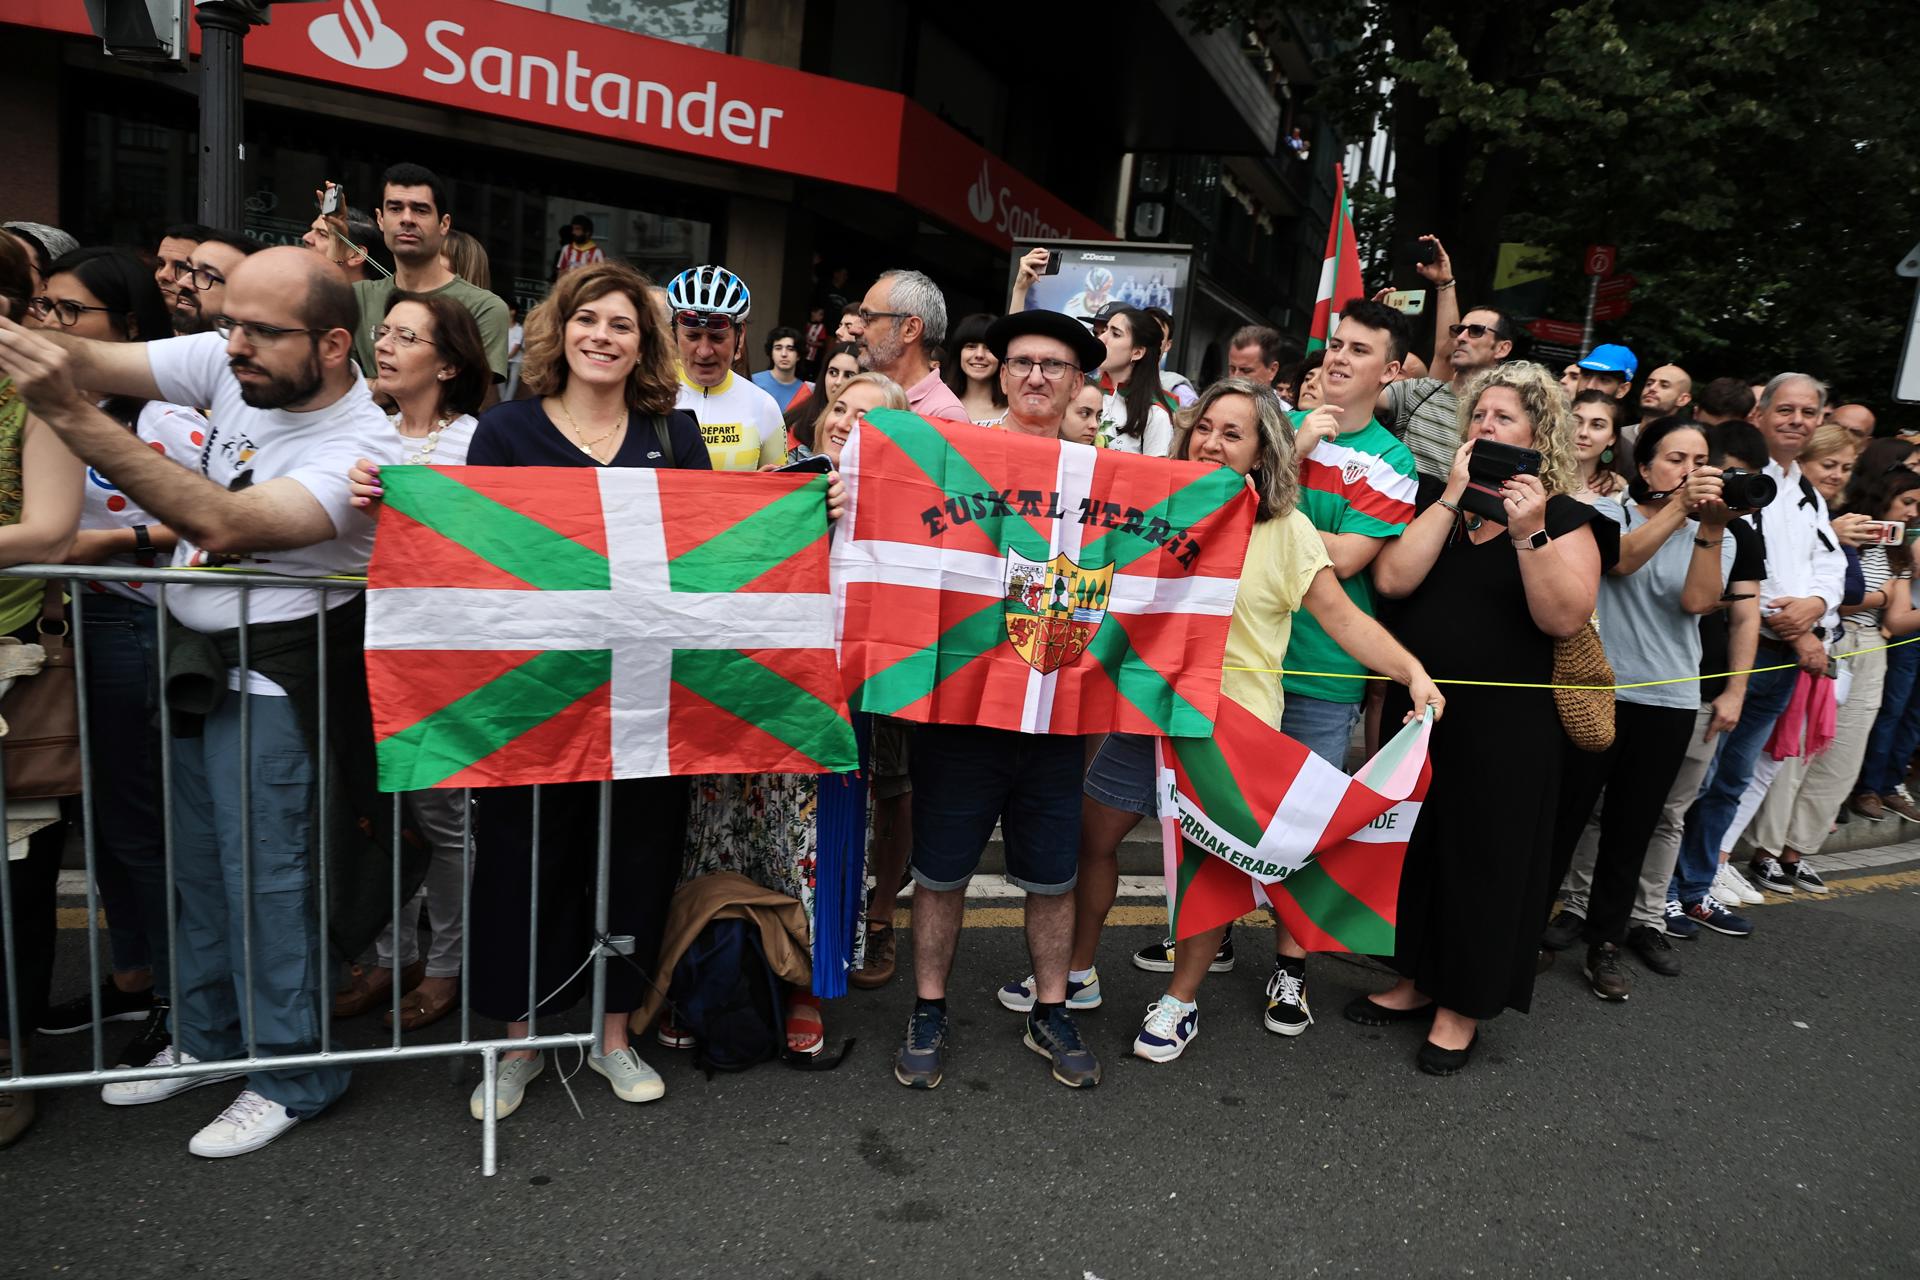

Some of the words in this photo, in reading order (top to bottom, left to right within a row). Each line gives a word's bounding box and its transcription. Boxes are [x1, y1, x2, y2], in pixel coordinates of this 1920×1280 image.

[423, 19, 784, 149] Santander
[702, 425, 736, 435] DÉPART
[721, 434, 740, 443] 2023
[920, 489, 1065, 538] EUSKAL
